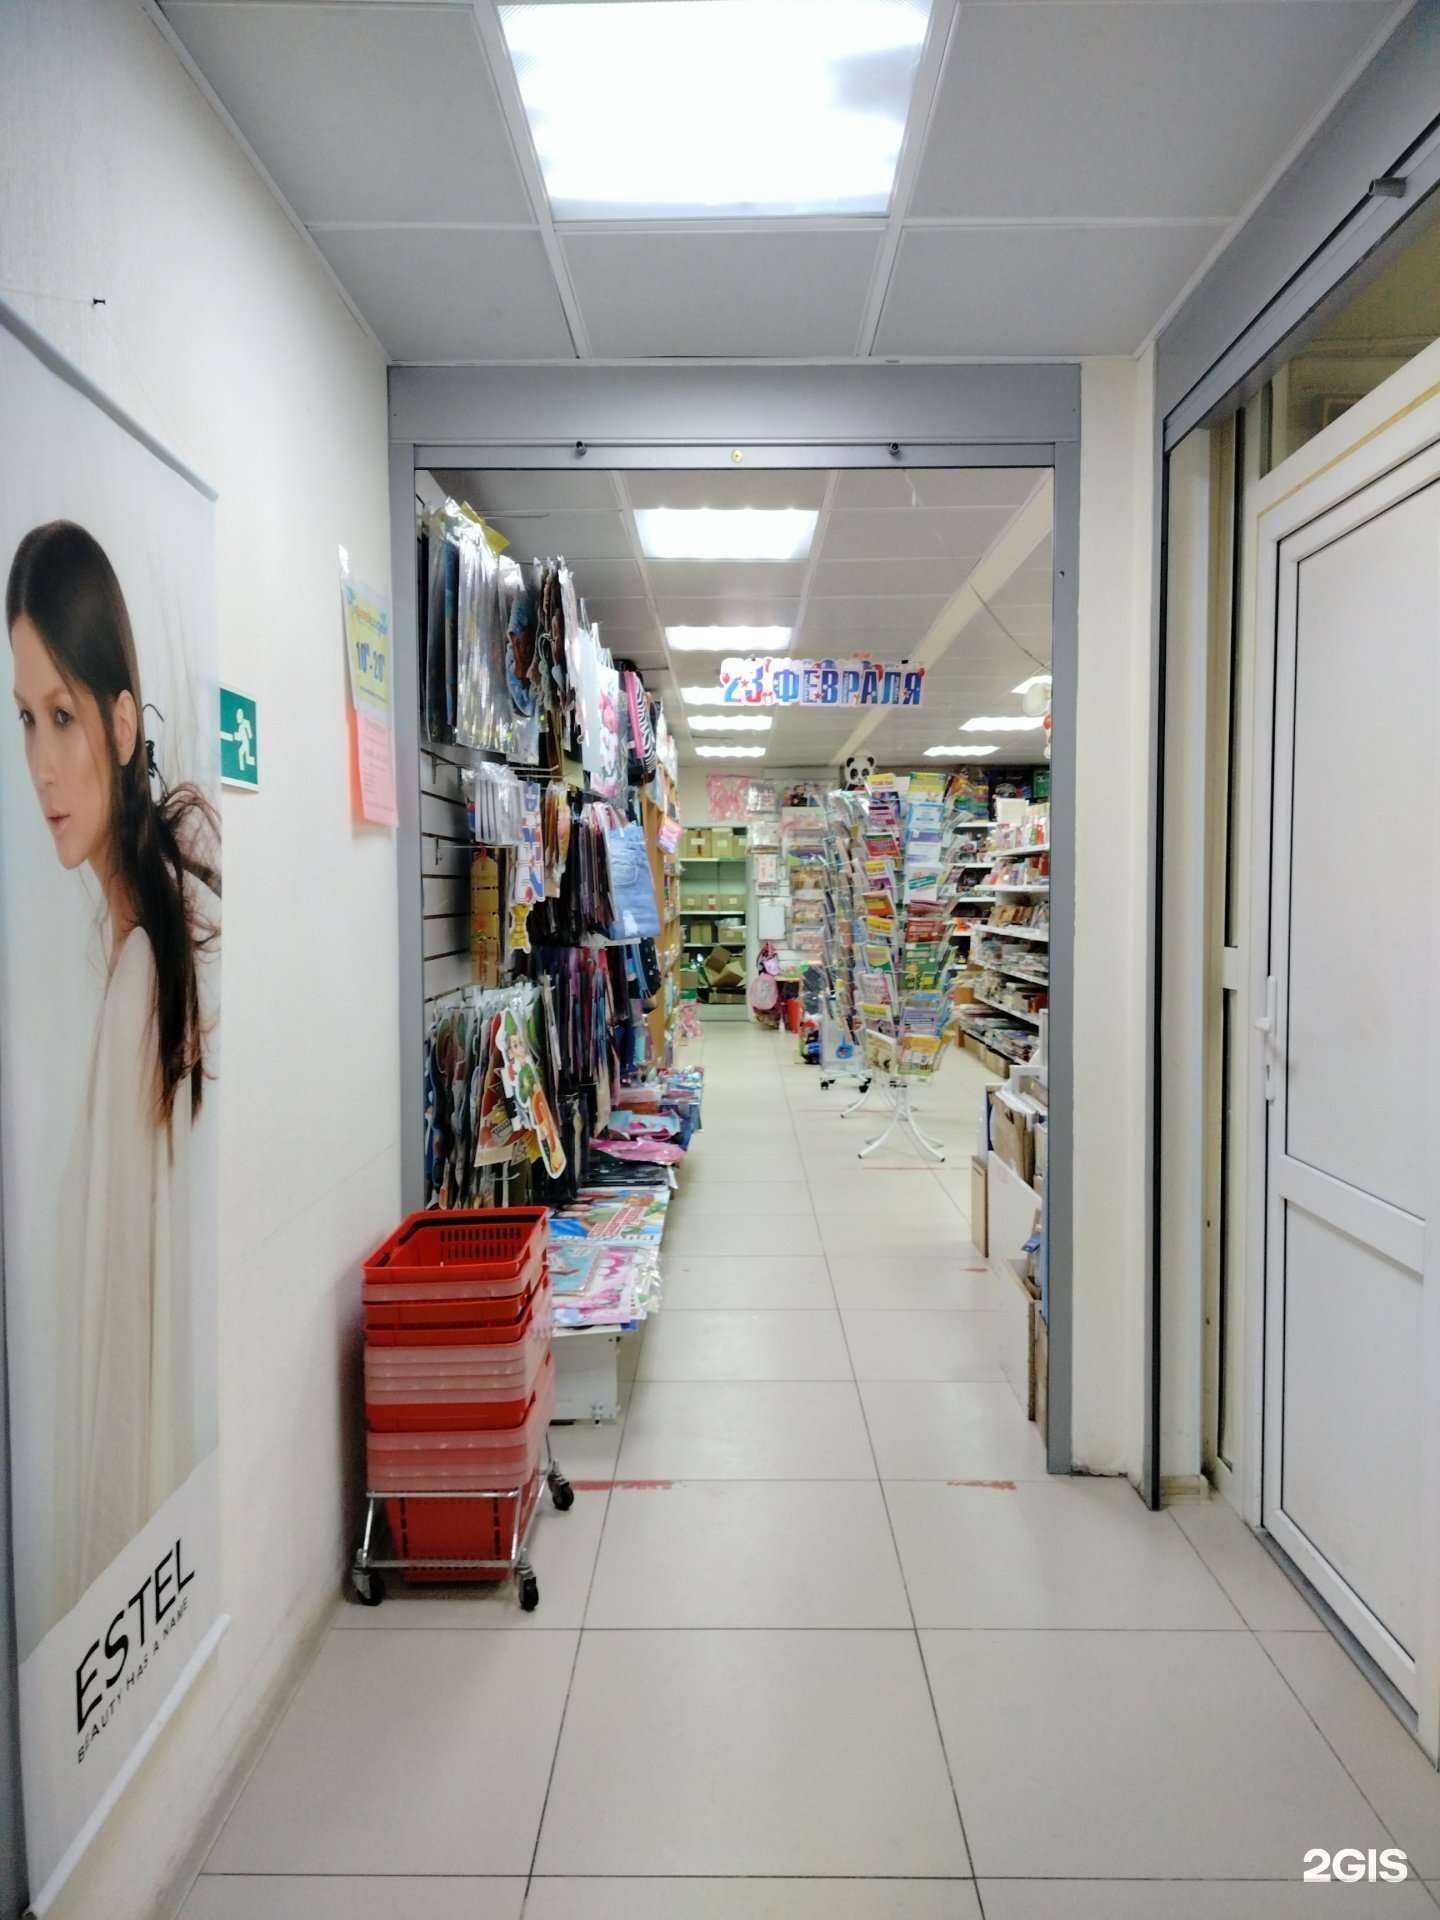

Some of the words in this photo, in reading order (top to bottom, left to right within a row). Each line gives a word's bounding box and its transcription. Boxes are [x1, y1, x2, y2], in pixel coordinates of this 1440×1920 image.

[724, 665, 764, 704] 23
[772, 668, 922, 705] ФЕВРАЛЯ
[75, 1536, 195, 1735] ESTEL
[77, 1693, 122, 1765] BEAUTY
